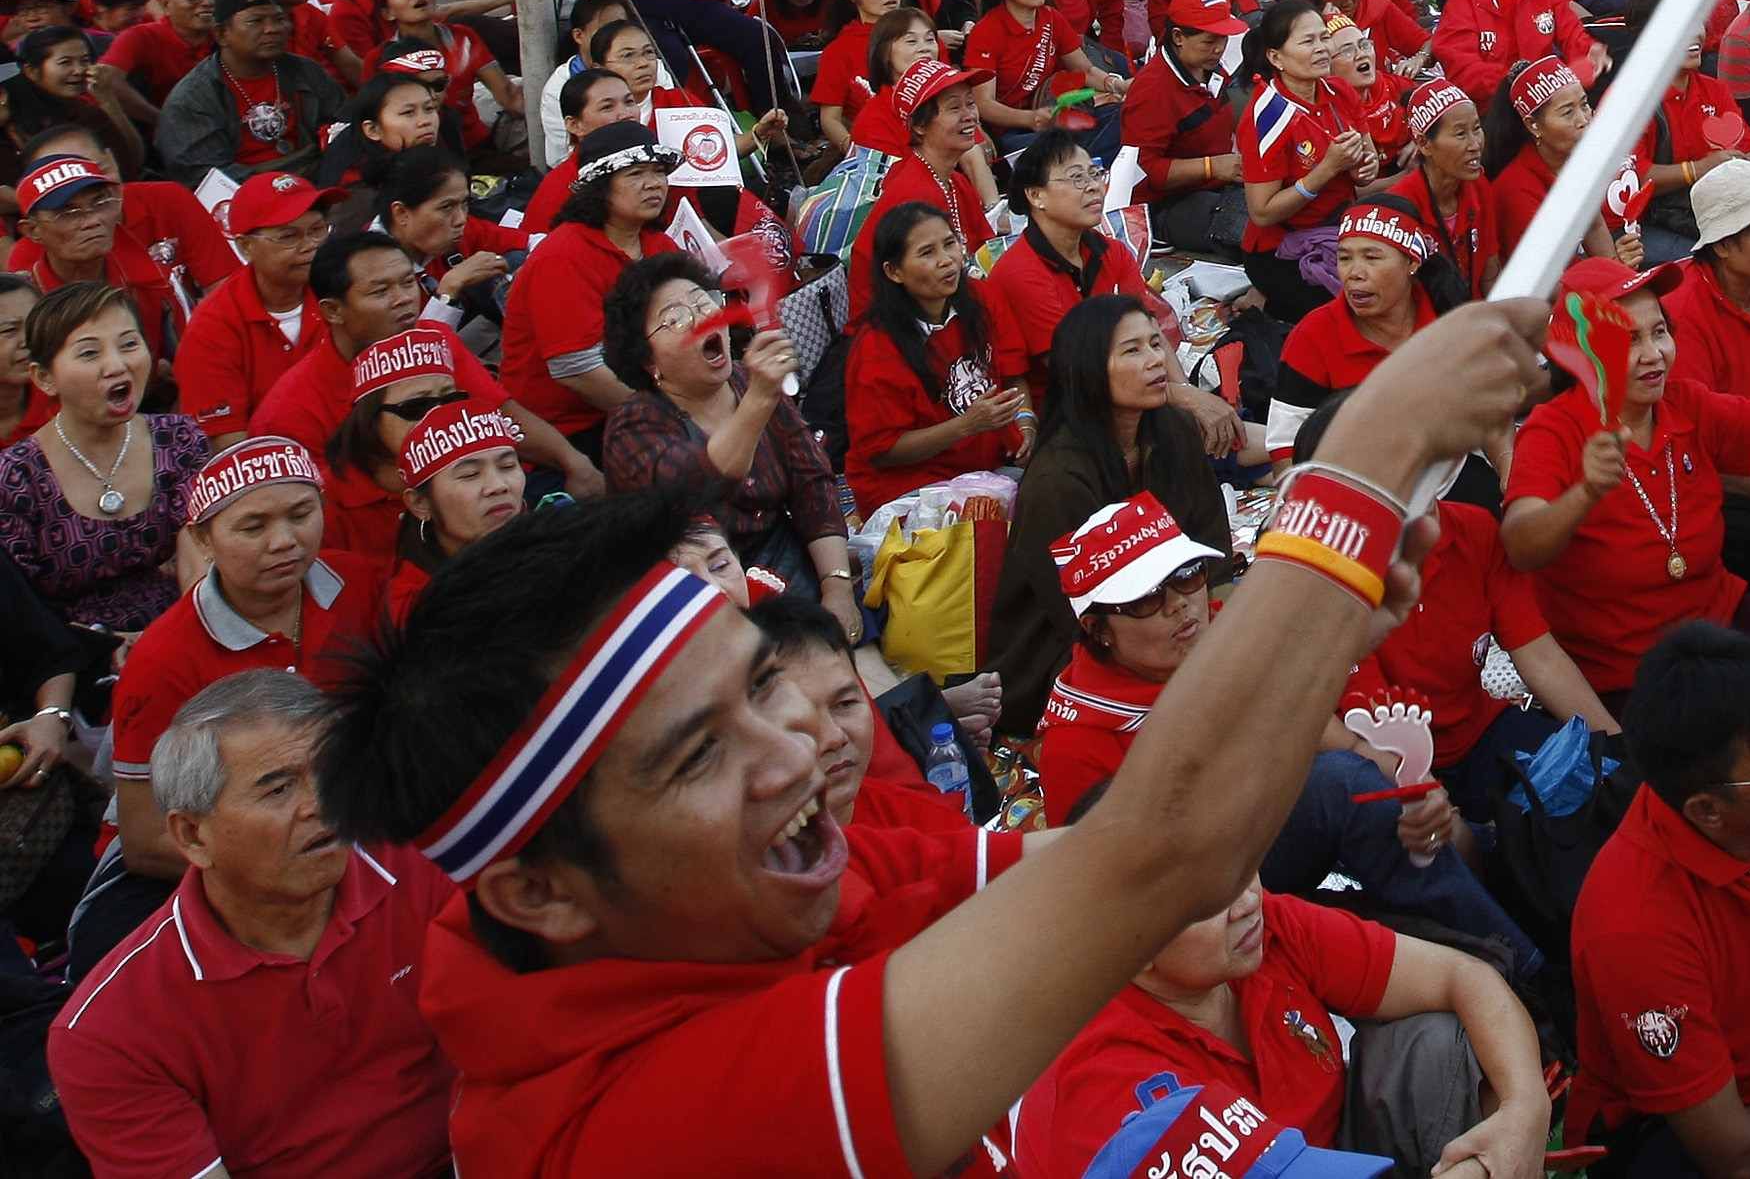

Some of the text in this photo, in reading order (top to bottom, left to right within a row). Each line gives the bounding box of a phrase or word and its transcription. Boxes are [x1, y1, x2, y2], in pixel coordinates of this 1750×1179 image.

[1355, 207, 1414, 249] เบื่อม็อบ
[1047, 698, 1078, 722] เรารัก
